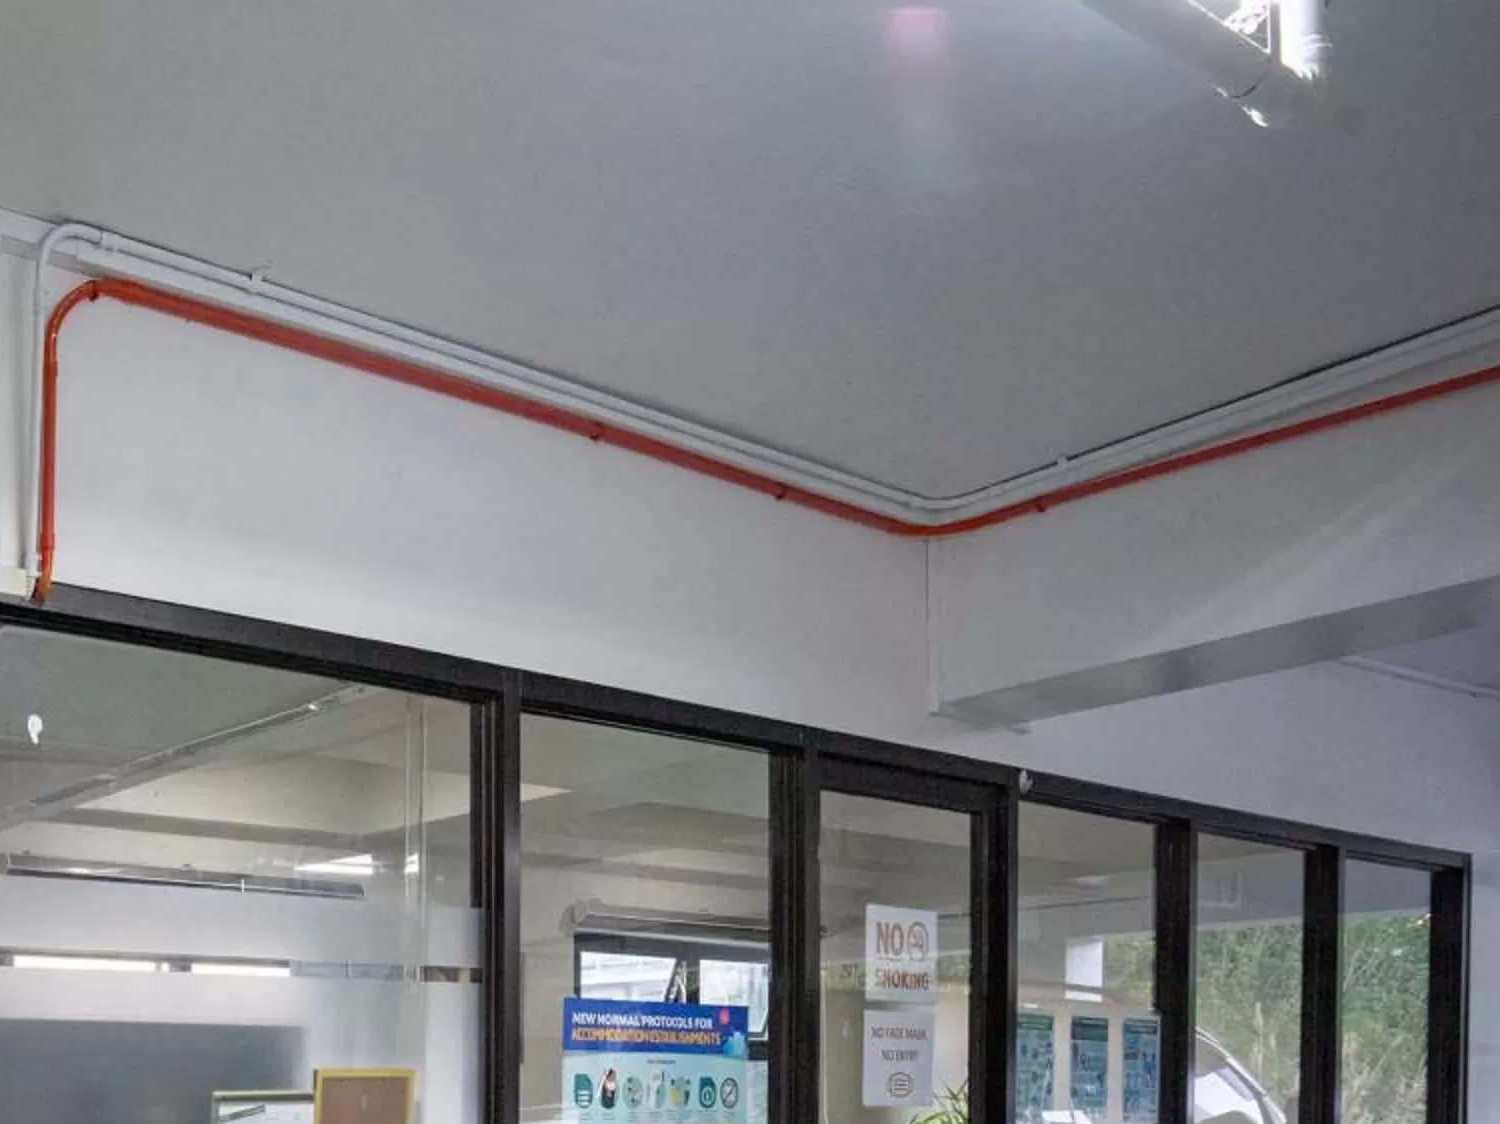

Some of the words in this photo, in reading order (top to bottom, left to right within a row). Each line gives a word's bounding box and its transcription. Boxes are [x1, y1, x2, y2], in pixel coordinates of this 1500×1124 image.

[876, 922, 904, 956] NO
[875, 968, 929, 991] SMOKING
[572, 1012, 597, 1025] NEW
[598, 1013, 641, 1027] NORMAL
[642, 1015, 693, 1029] PROTOCOLS
[695, 1018, 713, 1029] FOR
